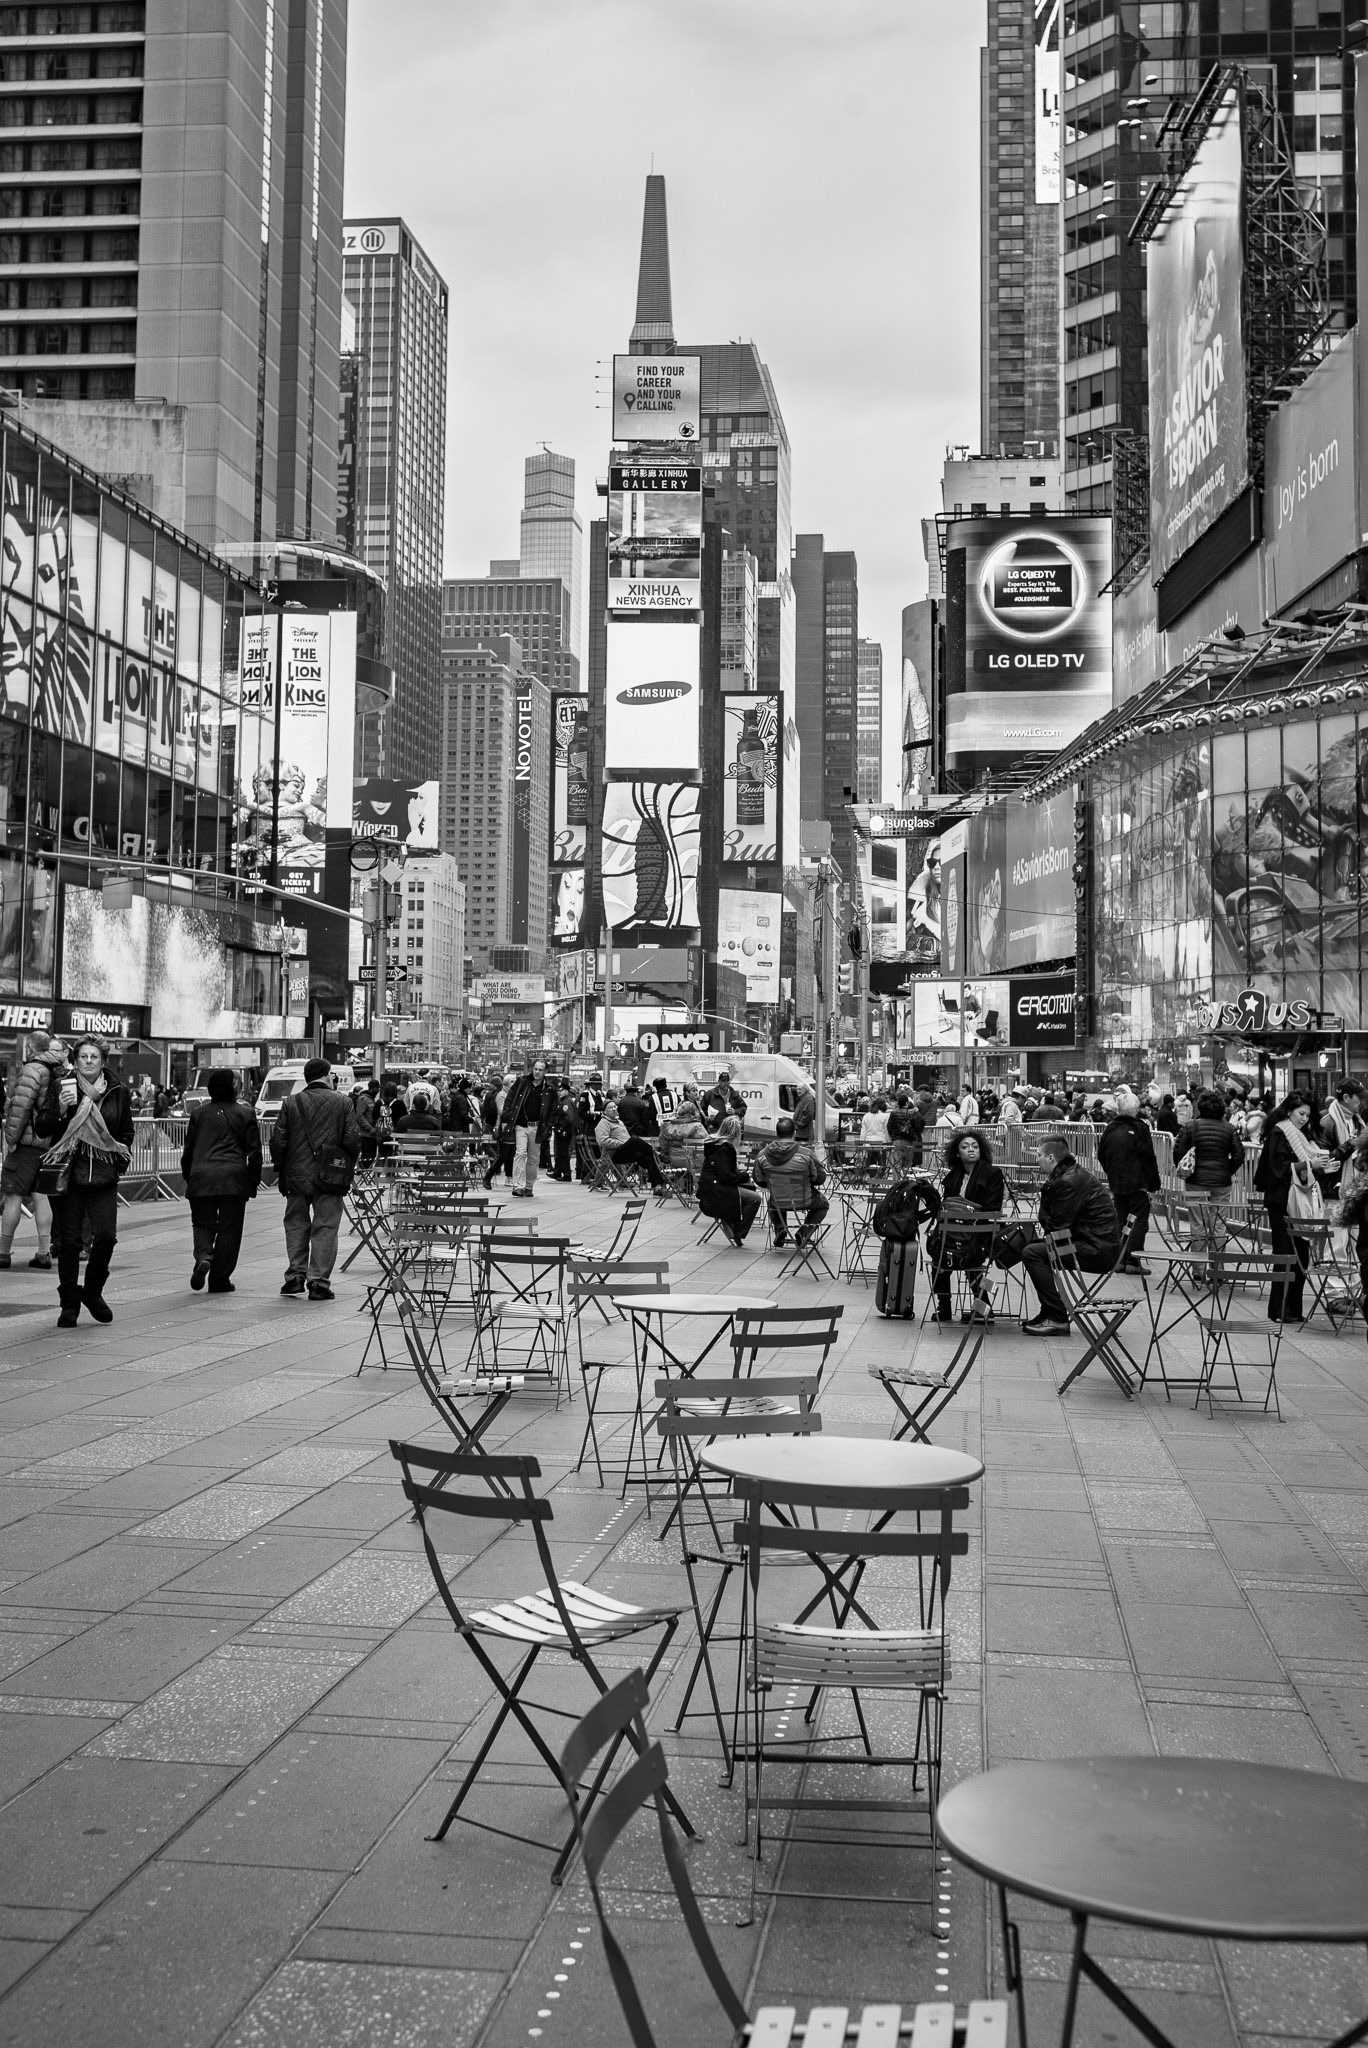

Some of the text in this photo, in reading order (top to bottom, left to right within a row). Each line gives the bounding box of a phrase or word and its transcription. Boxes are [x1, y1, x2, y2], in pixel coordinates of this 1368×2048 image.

[637, 366, 685, 376] FIND YOUR
[637, 377, 672, 388] CAREER
[637, 389, 681, 400] AND YOUR
[1163, 333, 1225, 456] A SAVIOR
[636, 400, 676, 411] CALLING.
[1169, 397, 1218, 491] IS BORN
[658, 469, 688, 478] XINHUA
[622, 480, 688, 489] GALLERY
[1278, 439, 1339, 530] Joy is born
[1008, 570, 1019, 579] LG
[1044, 570, 1056, 579] TV
[628, 584, 681, 596] XINHUA
[616, 597, 693, 606] NEWS AGENCY
[142, 596, 175, 650] THE
[292, 647, 317, 659] THE
[989, 653, 1085, 669] LG OLED TV
[103, 629, 158, 725] LION
[288, 662, 321, 681] LION
[285, 682, 326, 706] KING
[626, 687, 683, 699] SAMSUNG
[515, 688, 532, 780] NOVOTEL
[1002, 728, 1063, 738] www.LG.com
[888, 815, 936, 831] sunglass
[1012, 846, 1069, 887] #ASaviorIsBorn
[288, 976, 309, 991] JERSEY
[291, 989, 306, 1000] BOYS
[1268, 1000, 1311, 1027] US
[86, 1012, 122, 1033] TISSOT
[661, 1033, 710, 1051] NYC
